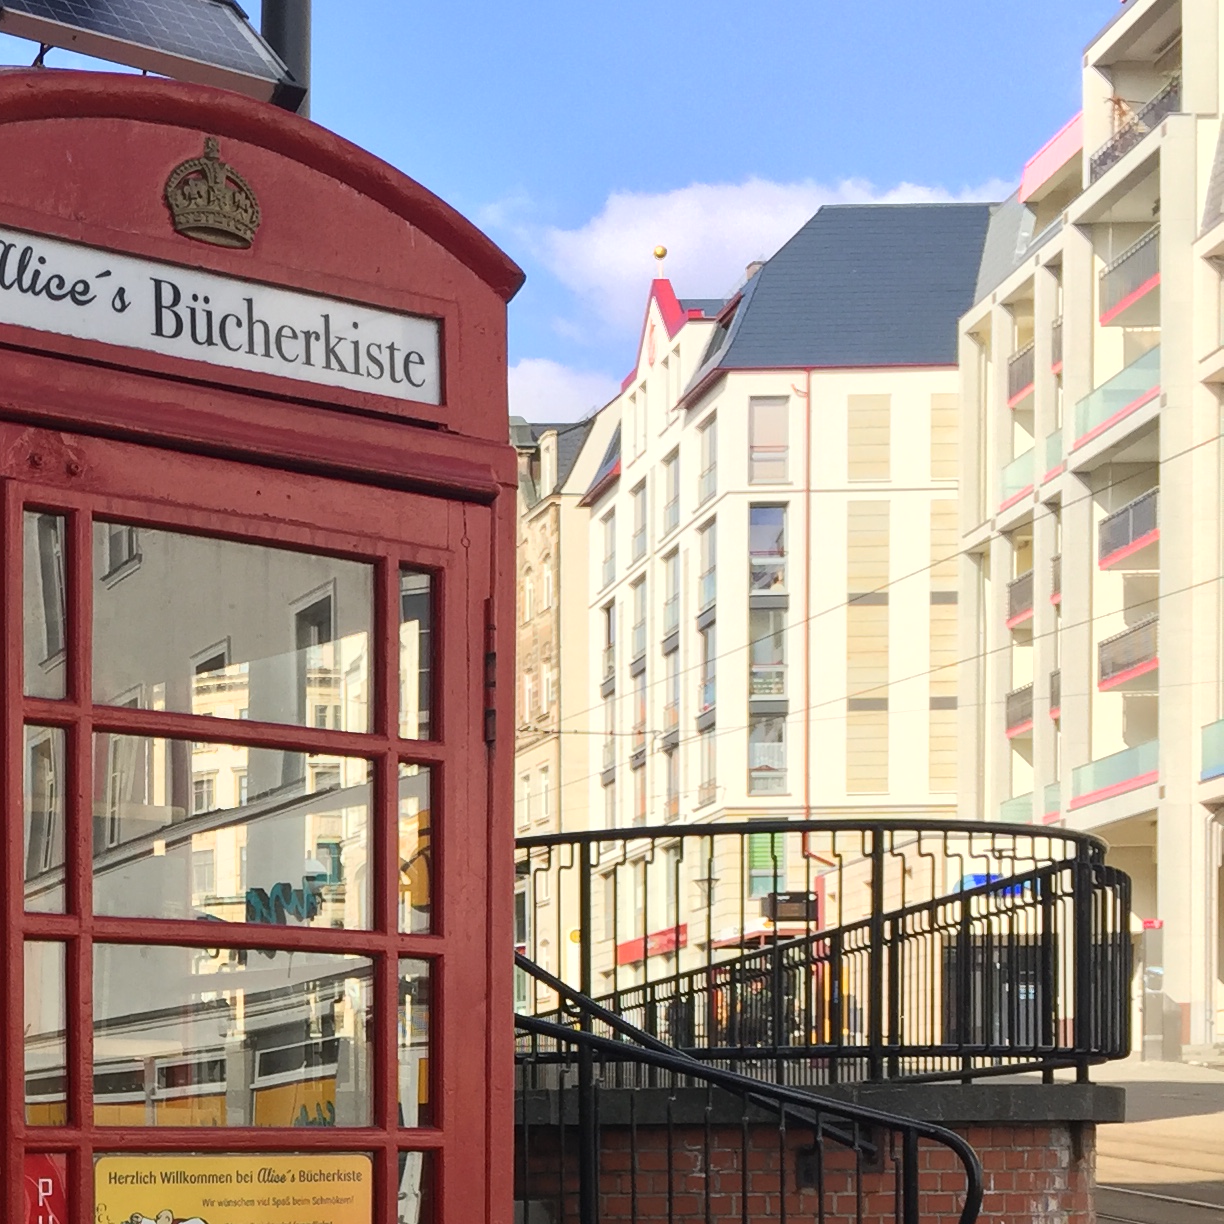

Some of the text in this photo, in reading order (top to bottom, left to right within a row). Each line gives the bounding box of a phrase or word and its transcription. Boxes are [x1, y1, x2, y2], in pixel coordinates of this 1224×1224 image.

[149, 276, 426, 388] Bücherkiste
[108, 1171, 157, 1185] Herzlich
[160, 1171, 233, 1184] Willkommen
[236, 1170, 254, 1184] bei
[298, 1169, 363, 1182] Bücherkiste
[202, 1198, 215, 1207] Wir
[217, 1198, 255, 1207] wünschen
[272, 1196, 291, 1208] Spaß
[292, 1195, 310, 1205] beim
